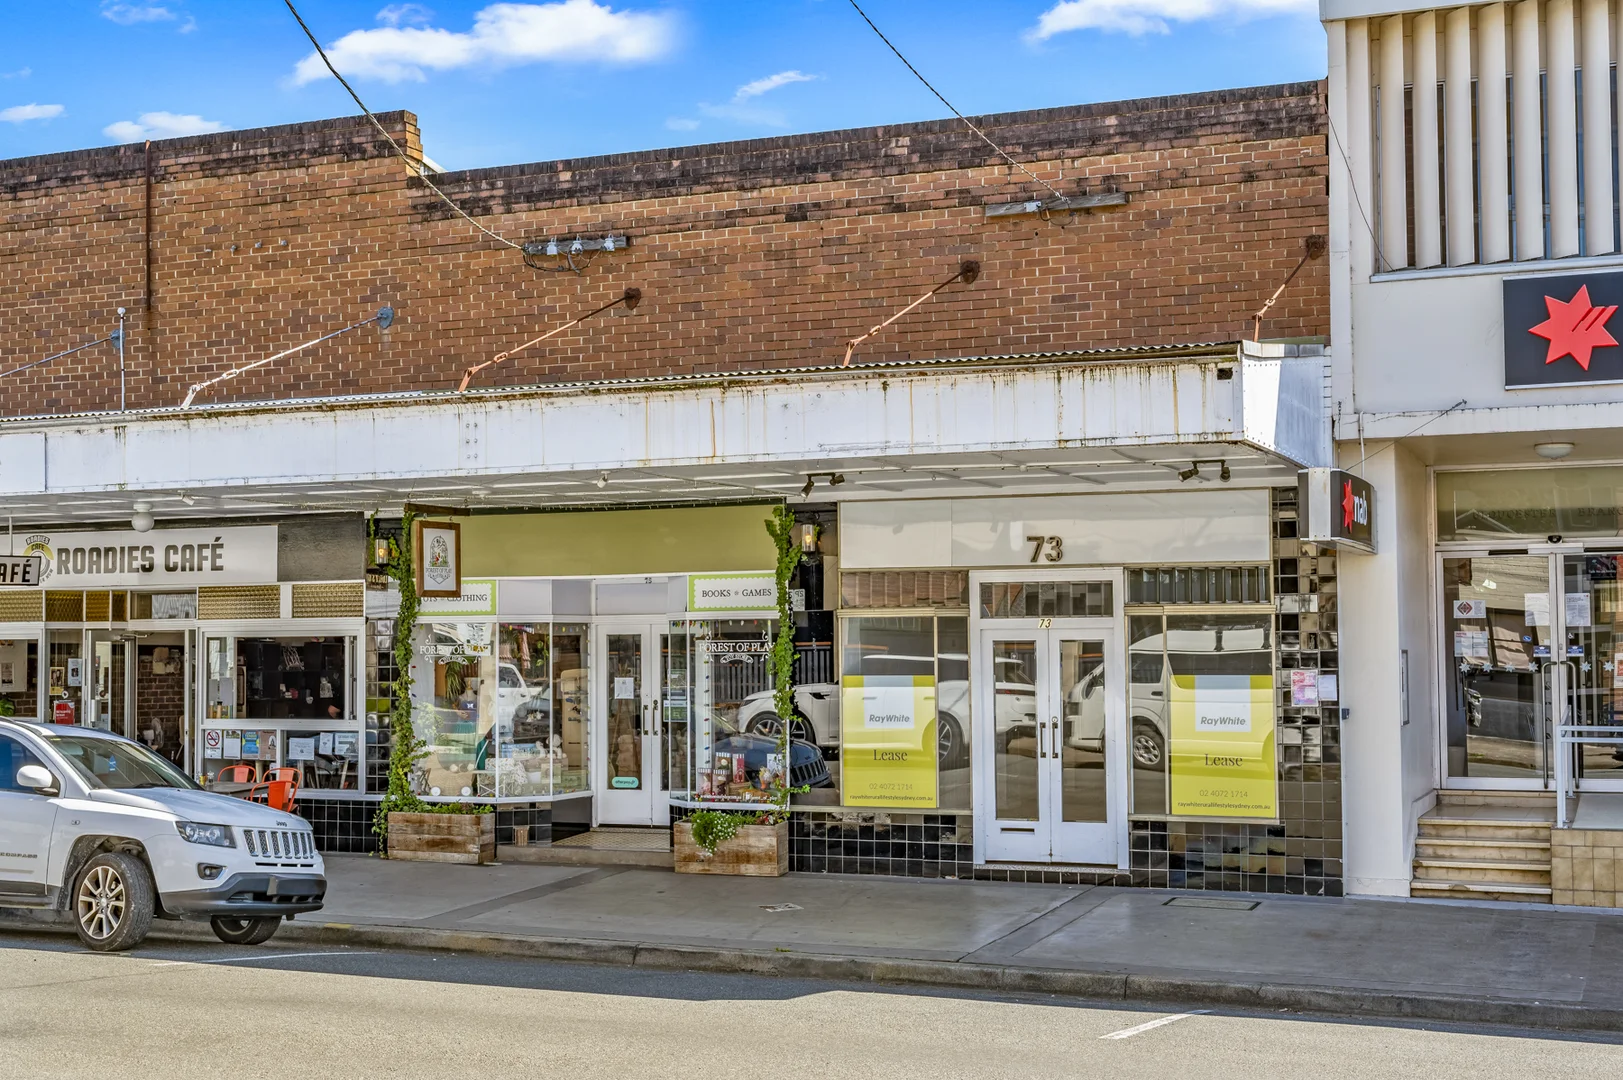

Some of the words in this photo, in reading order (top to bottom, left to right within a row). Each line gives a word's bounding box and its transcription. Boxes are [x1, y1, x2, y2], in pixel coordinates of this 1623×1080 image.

[1354, 490, 1368, 526] nab
[1026, 536, 1063, 563] 73
[57, 546, 155, 575] ROADIES
[164, 536, 224, 573] CAFÉ
[702, 589, 731, 598] BOOKS
[742, 588, 772, 597] GAMES
[1039, 618, 1052, 629] 73
[700, 642, 736, 652] FOREST
[736, 642, 750, 652] OF
[869, 714, 911, 723] RayWhite
[1200, 716, 1246, 726] RayWhite
[873, 749, 908, 761] Lease
[1204, 754, 1243, 767] Lease
[1199, 789, 1209, 797] 02
[1210, 790, 1229, 798] 4072
